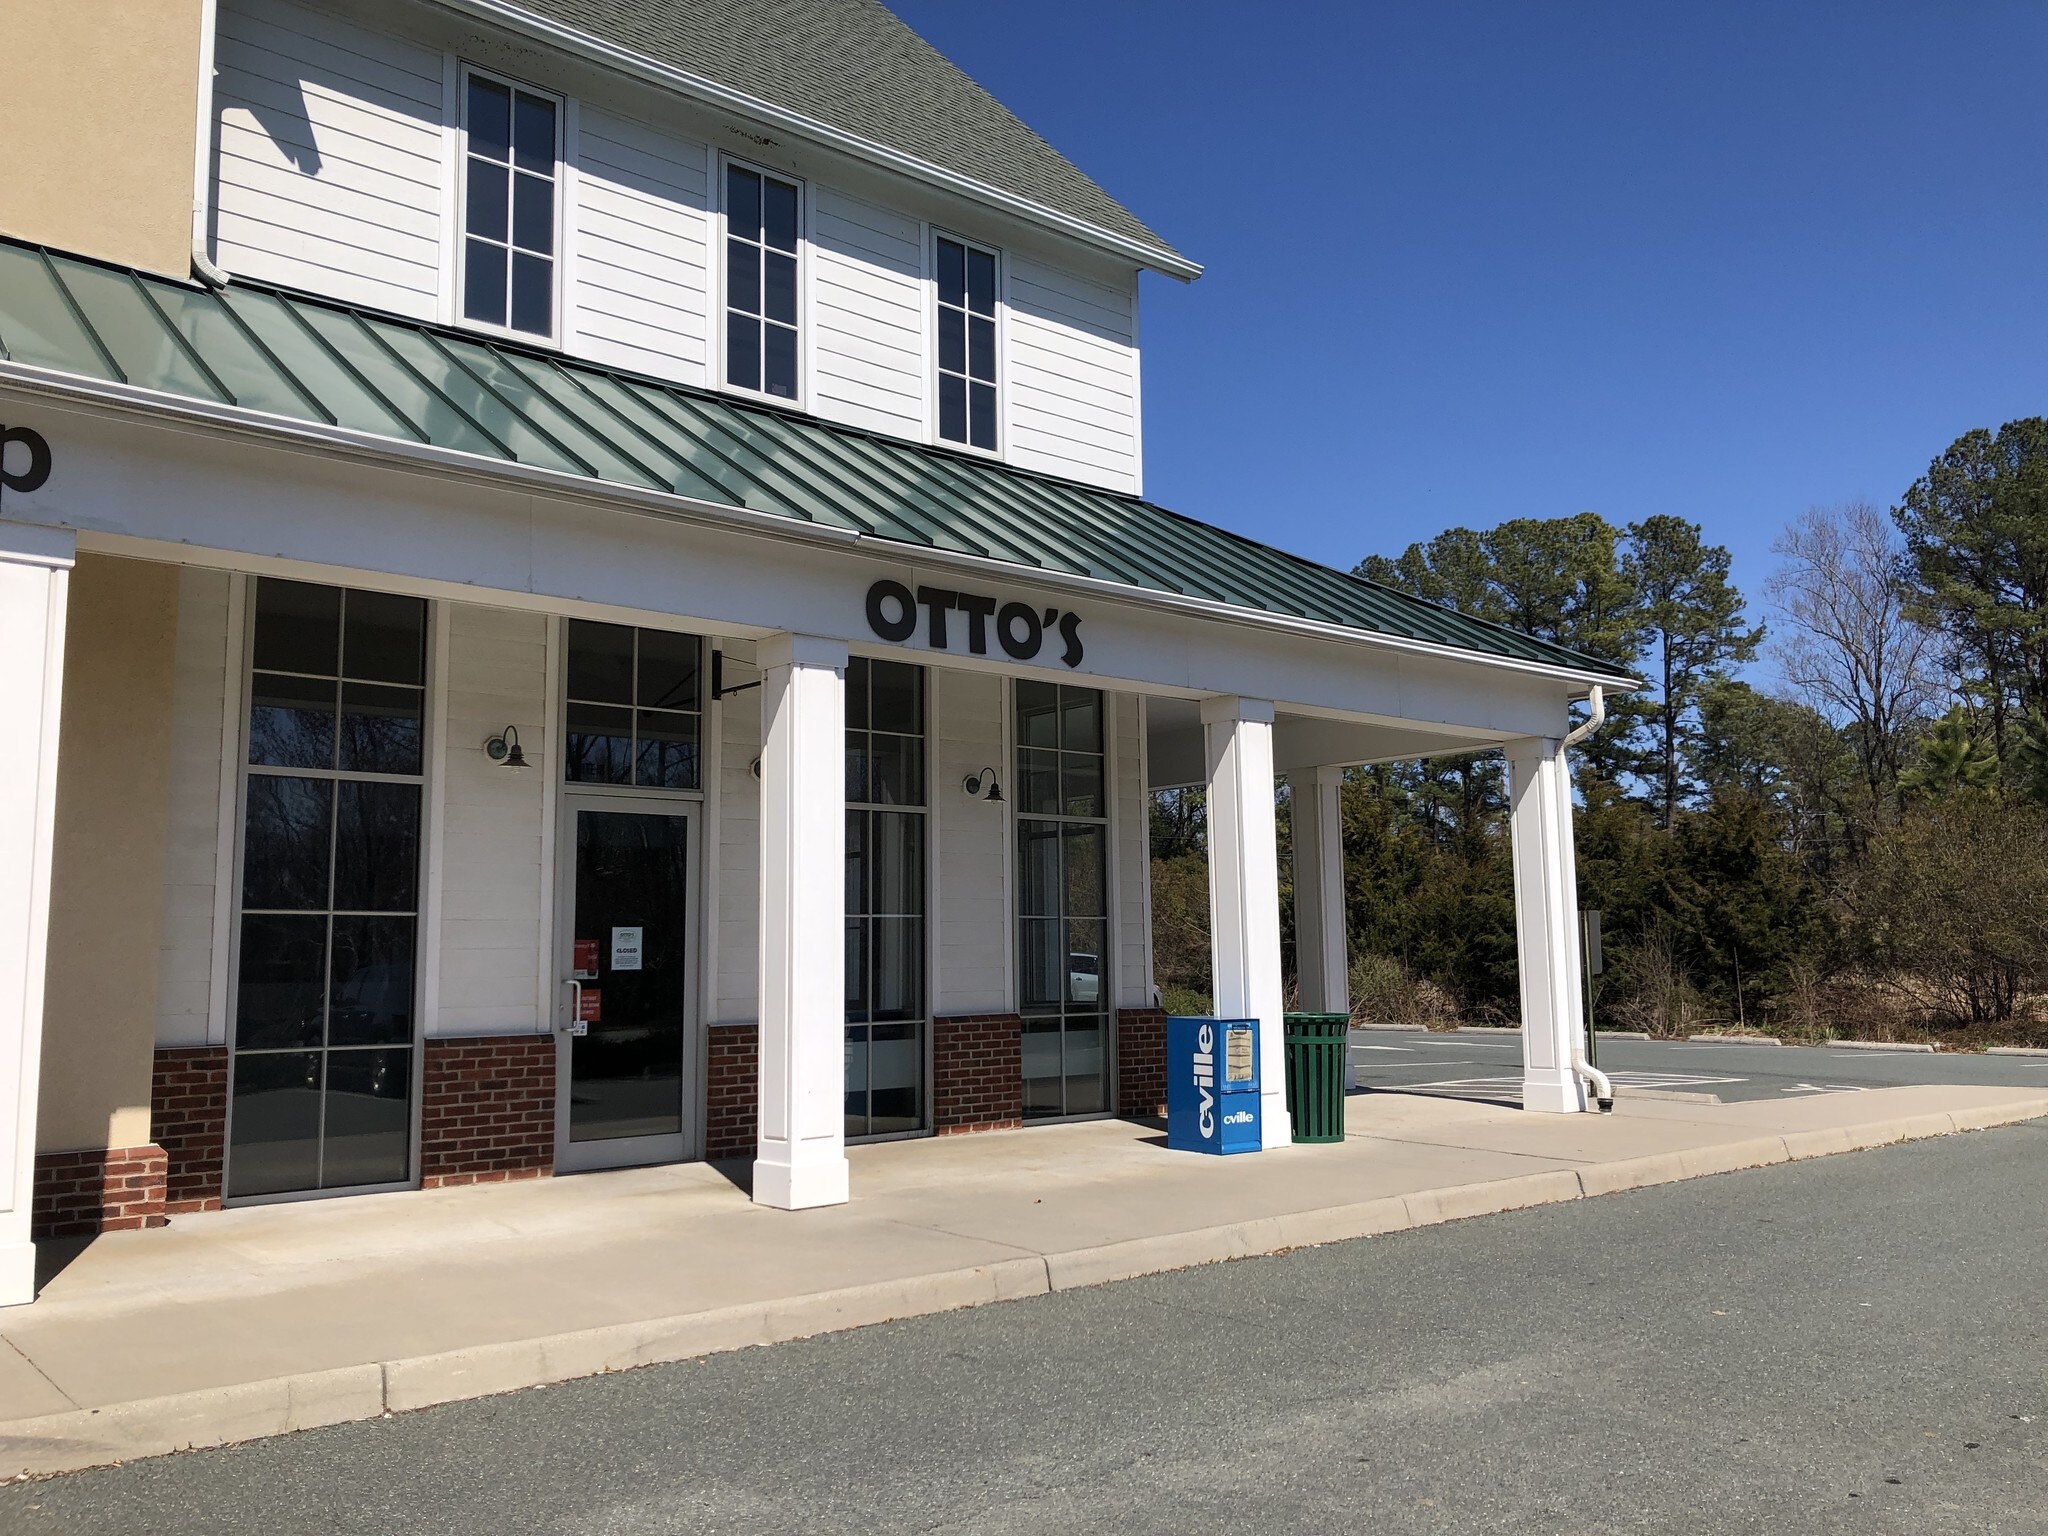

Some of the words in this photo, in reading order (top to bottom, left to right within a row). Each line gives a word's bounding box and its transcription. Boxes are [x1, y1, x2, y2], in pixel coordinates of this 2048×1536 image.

[866, 580, 1084, 669] OTTO'S
[1193, 1024, 1214, 1139] cville
[1223, 1111, 1254, 1125] cville
